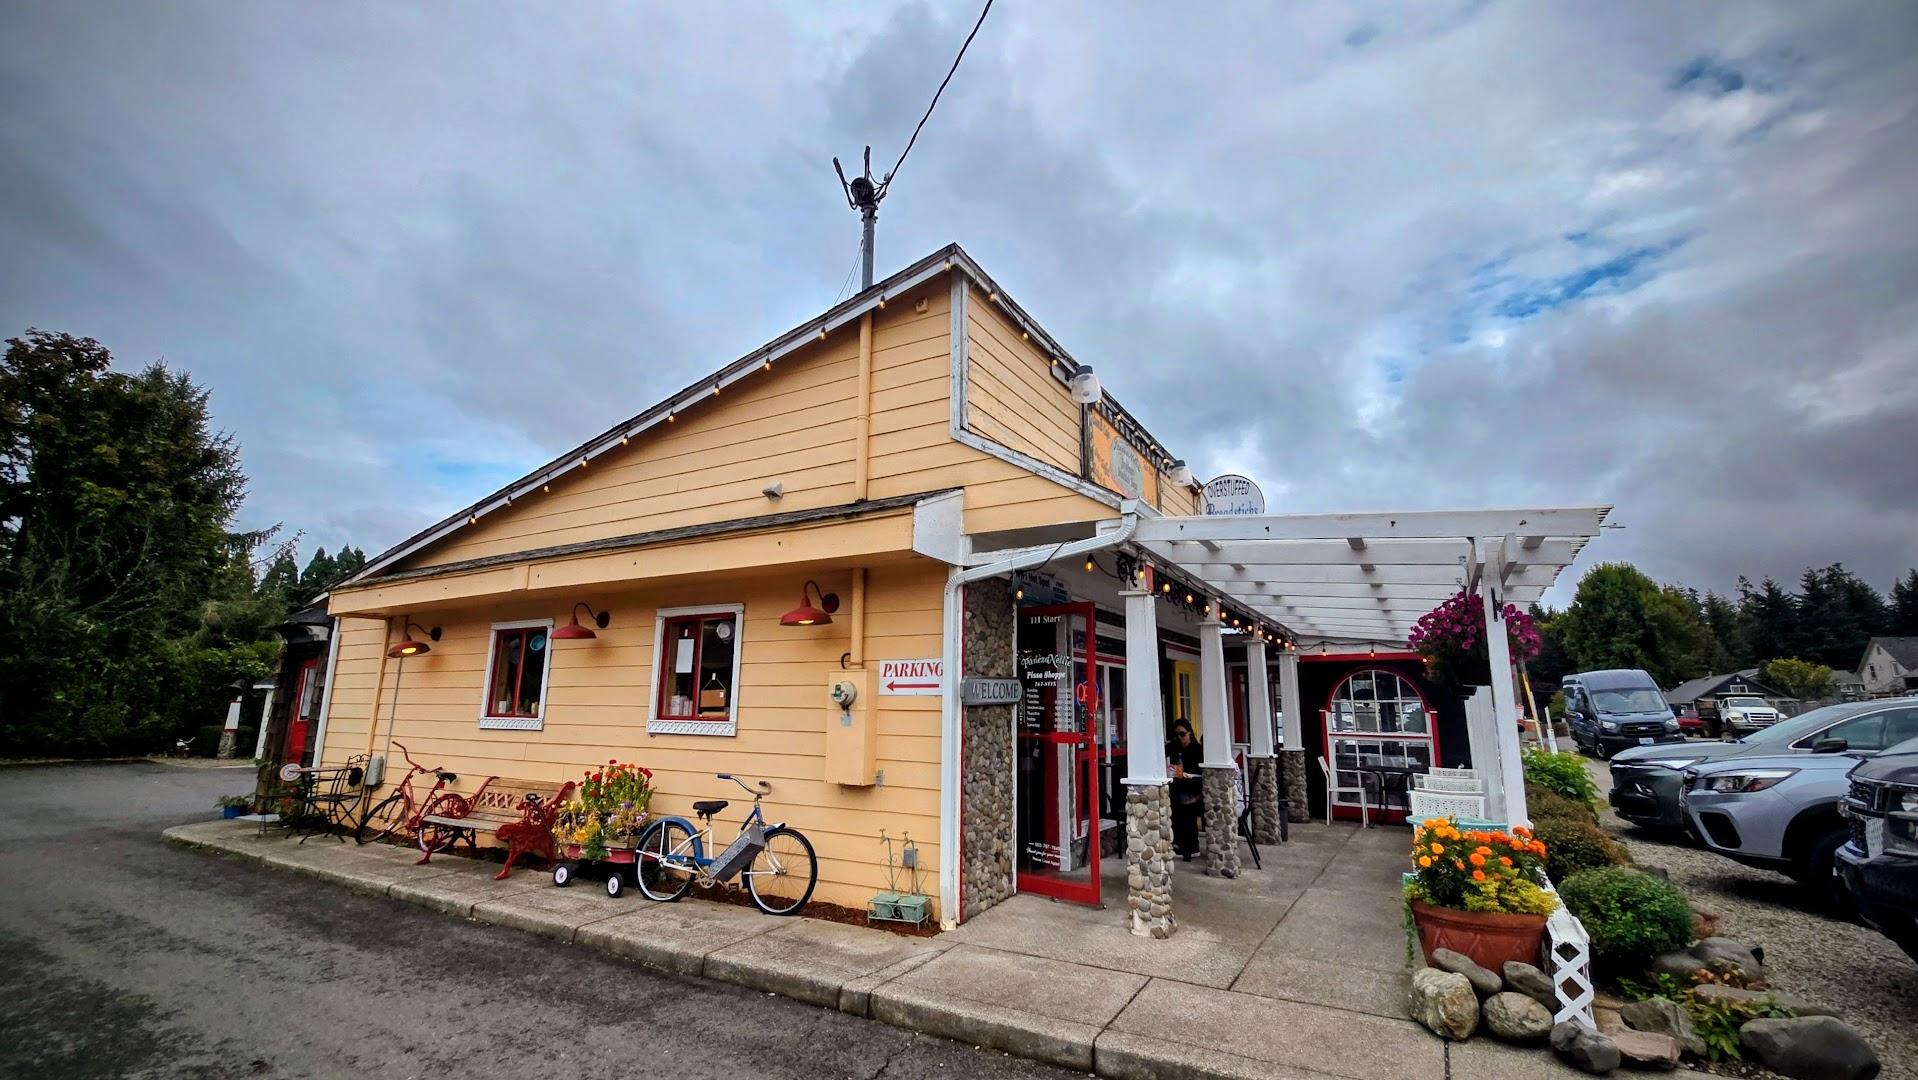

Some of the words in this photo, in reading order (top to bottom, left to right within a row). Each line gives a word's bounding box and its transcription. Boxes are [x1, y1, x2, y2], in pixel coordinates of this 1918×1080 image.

[1207, 479, 1250, 498] OVERSTUFFED
[1042, 615, 1061, 624] Starr
[882, 662, 943, 678] PARKING
[971, 681, 1019, 700] WELCOME
